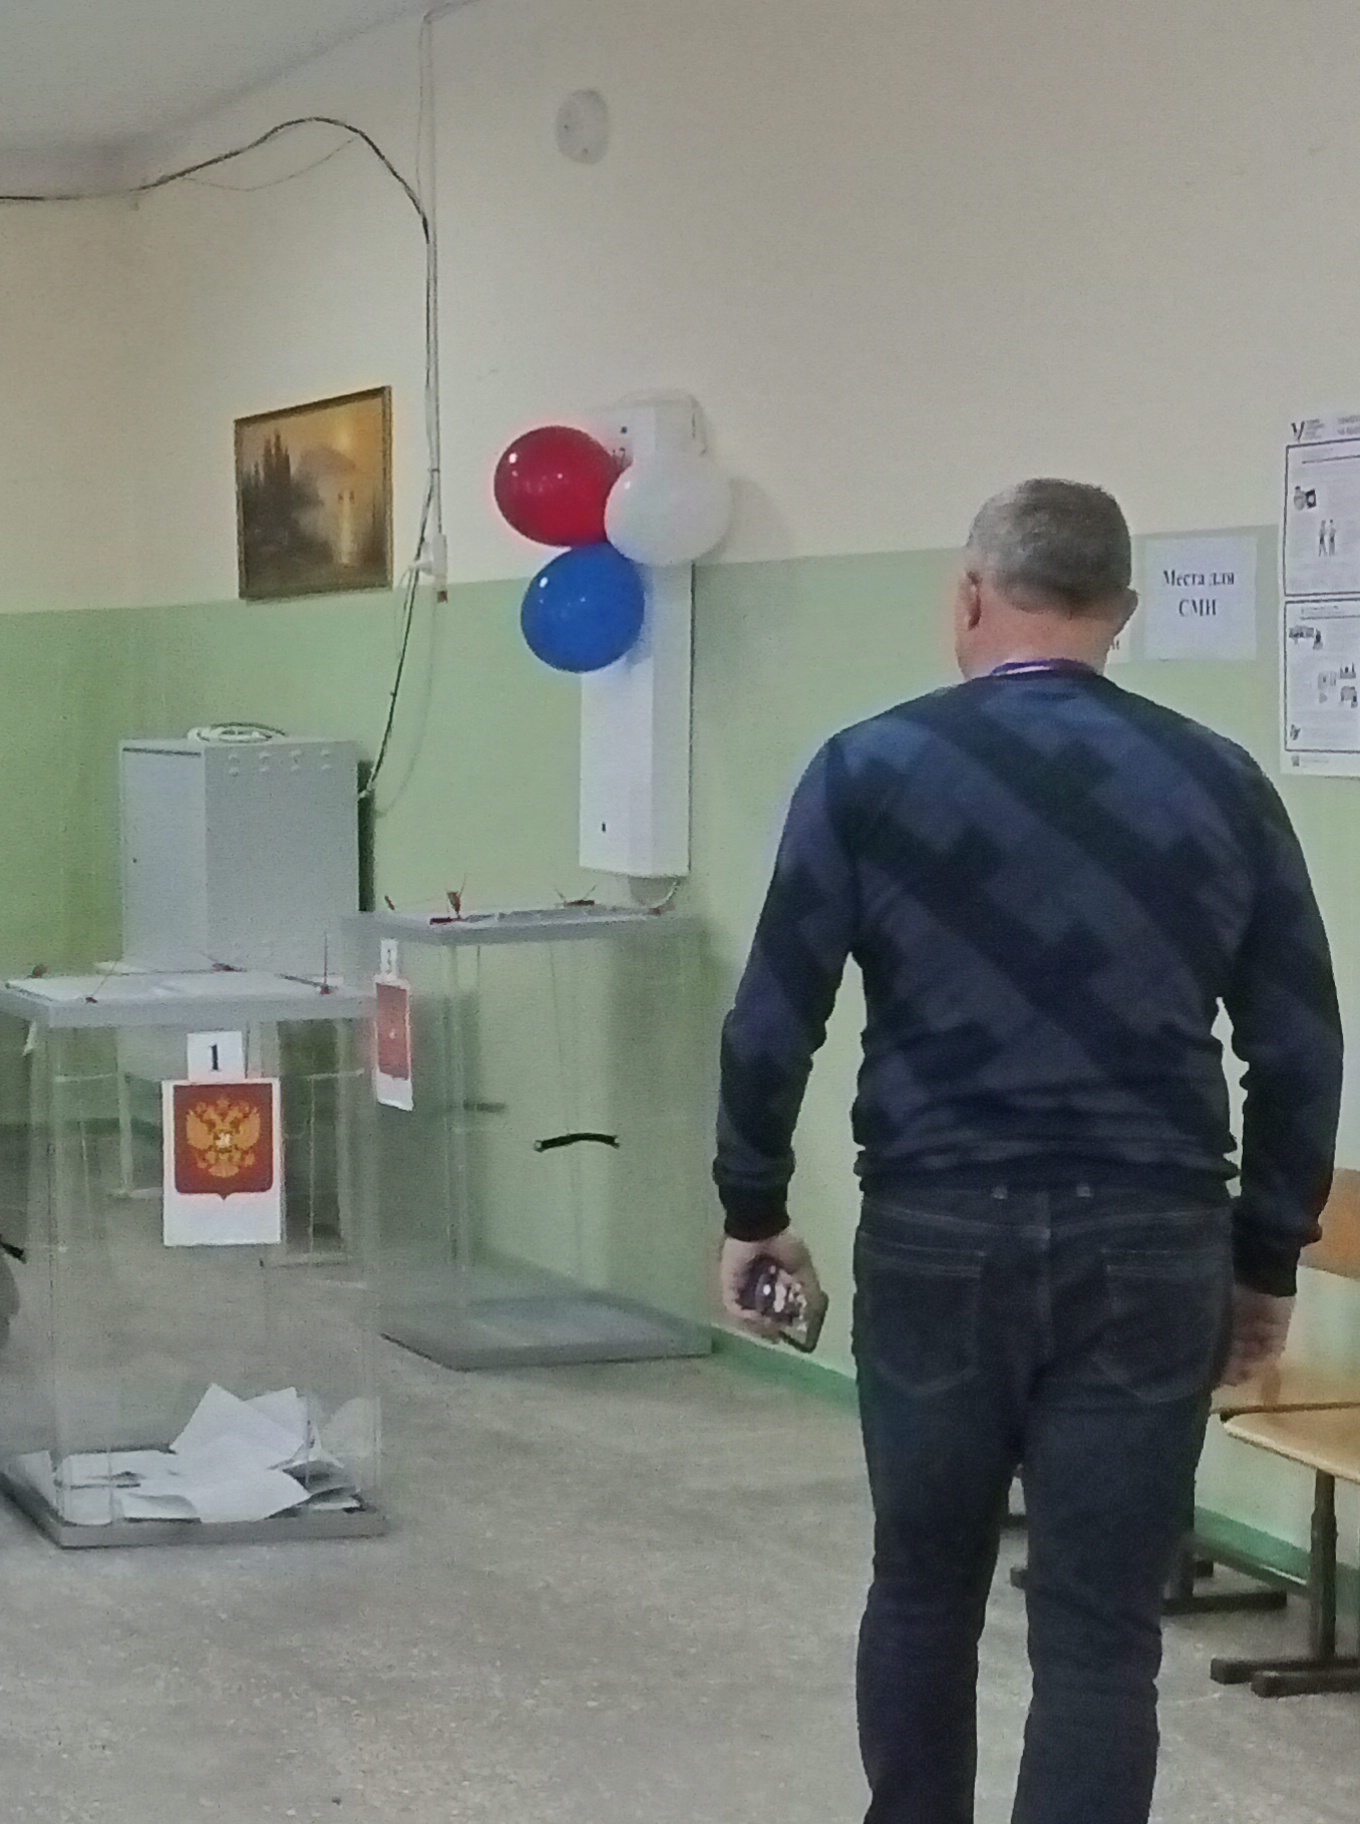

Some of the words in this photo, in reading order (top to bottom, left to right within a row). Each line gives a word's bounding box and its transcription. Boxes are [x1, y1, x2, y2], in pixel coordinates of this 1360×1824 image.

[1163, 568, 1205, 587] Места
[1209, 571, 1235, 587] для
[1178, 598, 1217, 617] СМИ
[209, 1043, 221, 1072] 1
